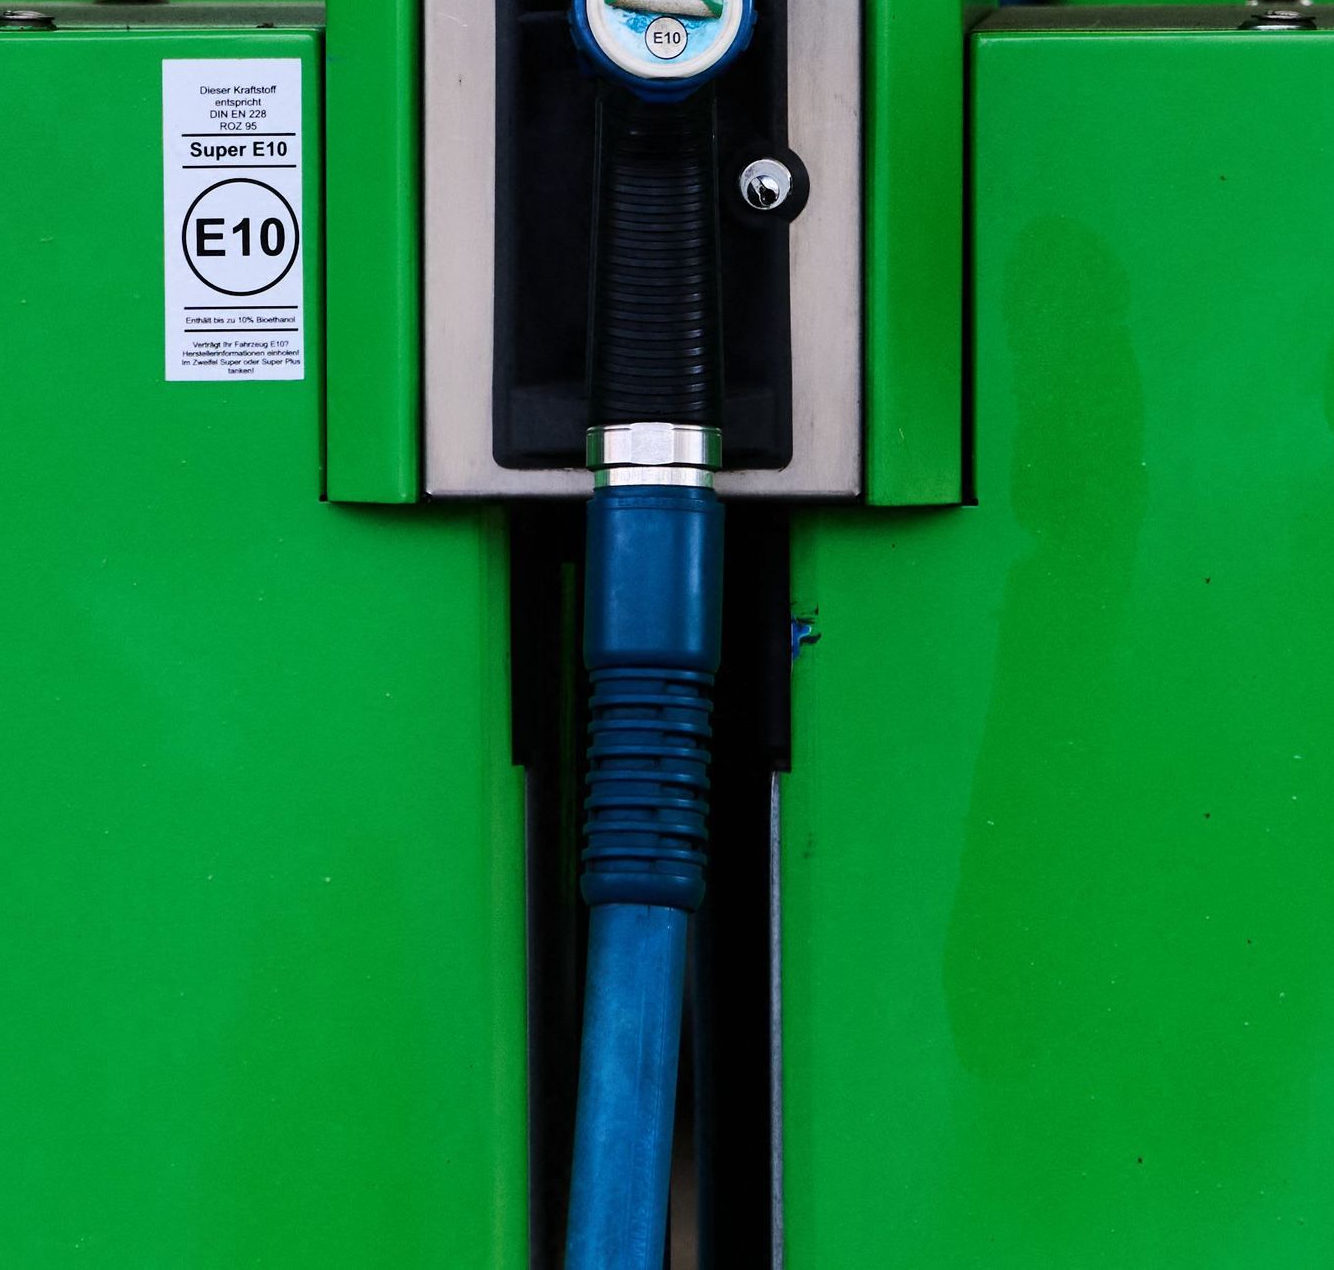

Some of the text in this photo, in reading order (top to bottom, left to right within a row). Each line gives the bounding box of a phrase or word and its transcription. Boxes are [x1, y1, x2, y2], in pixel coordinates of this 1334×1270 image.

[653, 32, 681, 44] E10
[200, 85, 277, 94] Dieser Kraftstoff
[215, 98, 261, 107] entspricht
[210, 110, 267, 119] DIN EN 228
[220, 122, 257, 130] ROZ 95
[190, 141, 288, 161] Super E10
[196, 217, 285, 256] E10
[256, 316, 296, 324] Bioethanol
[235, 341, 268, 349] Fahrzeug
[220, 359, 241, 367] Super
[261, 358, 283, 366] Super
